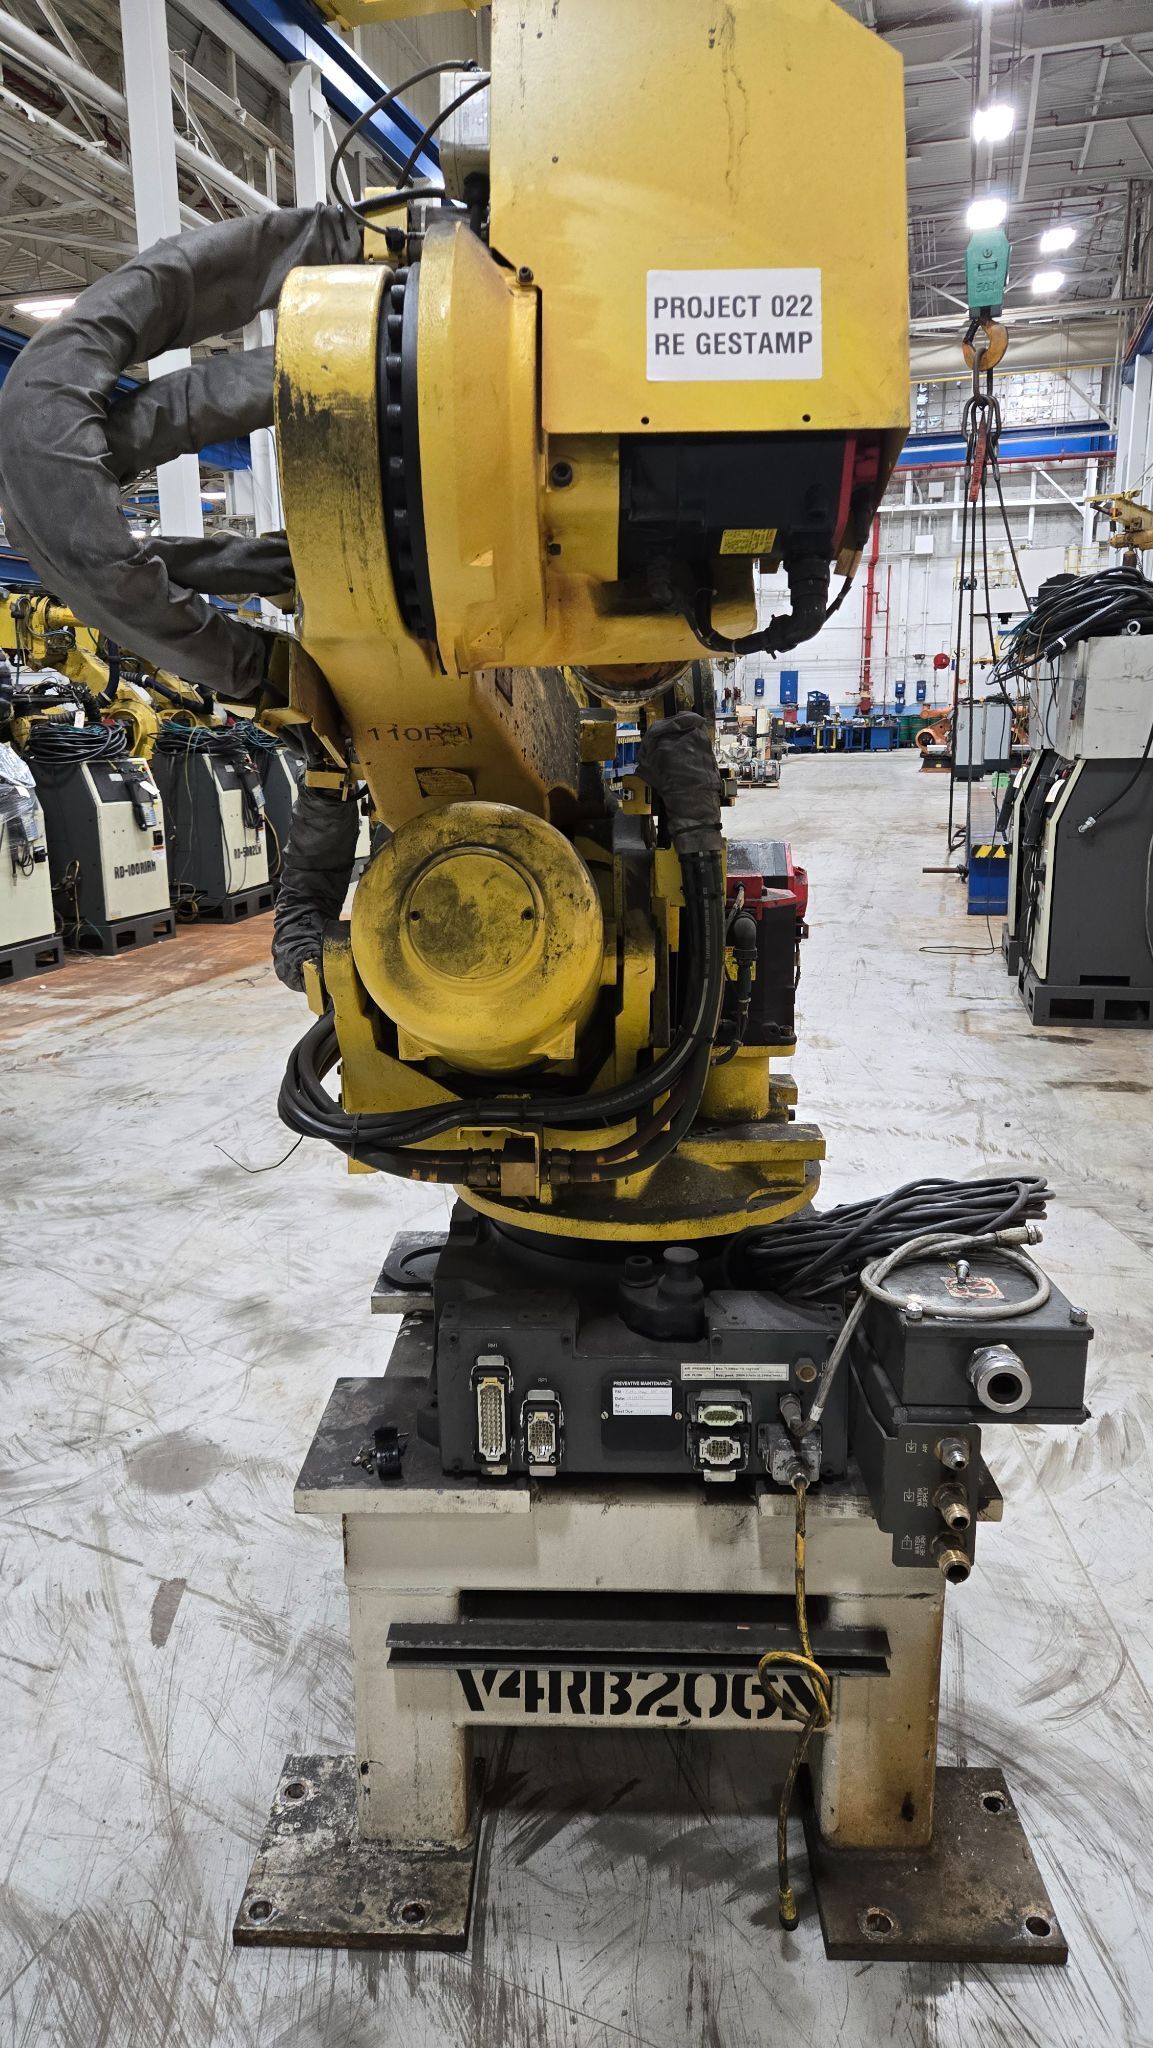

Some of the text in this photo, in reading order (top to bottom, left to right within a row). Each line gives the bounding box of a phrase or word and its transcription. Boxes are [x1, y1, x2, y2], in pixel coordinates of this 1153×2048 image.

[654, 294, 813, 319] PROJECT 022
[655, 331, 813, 355] RE GESTAMP
